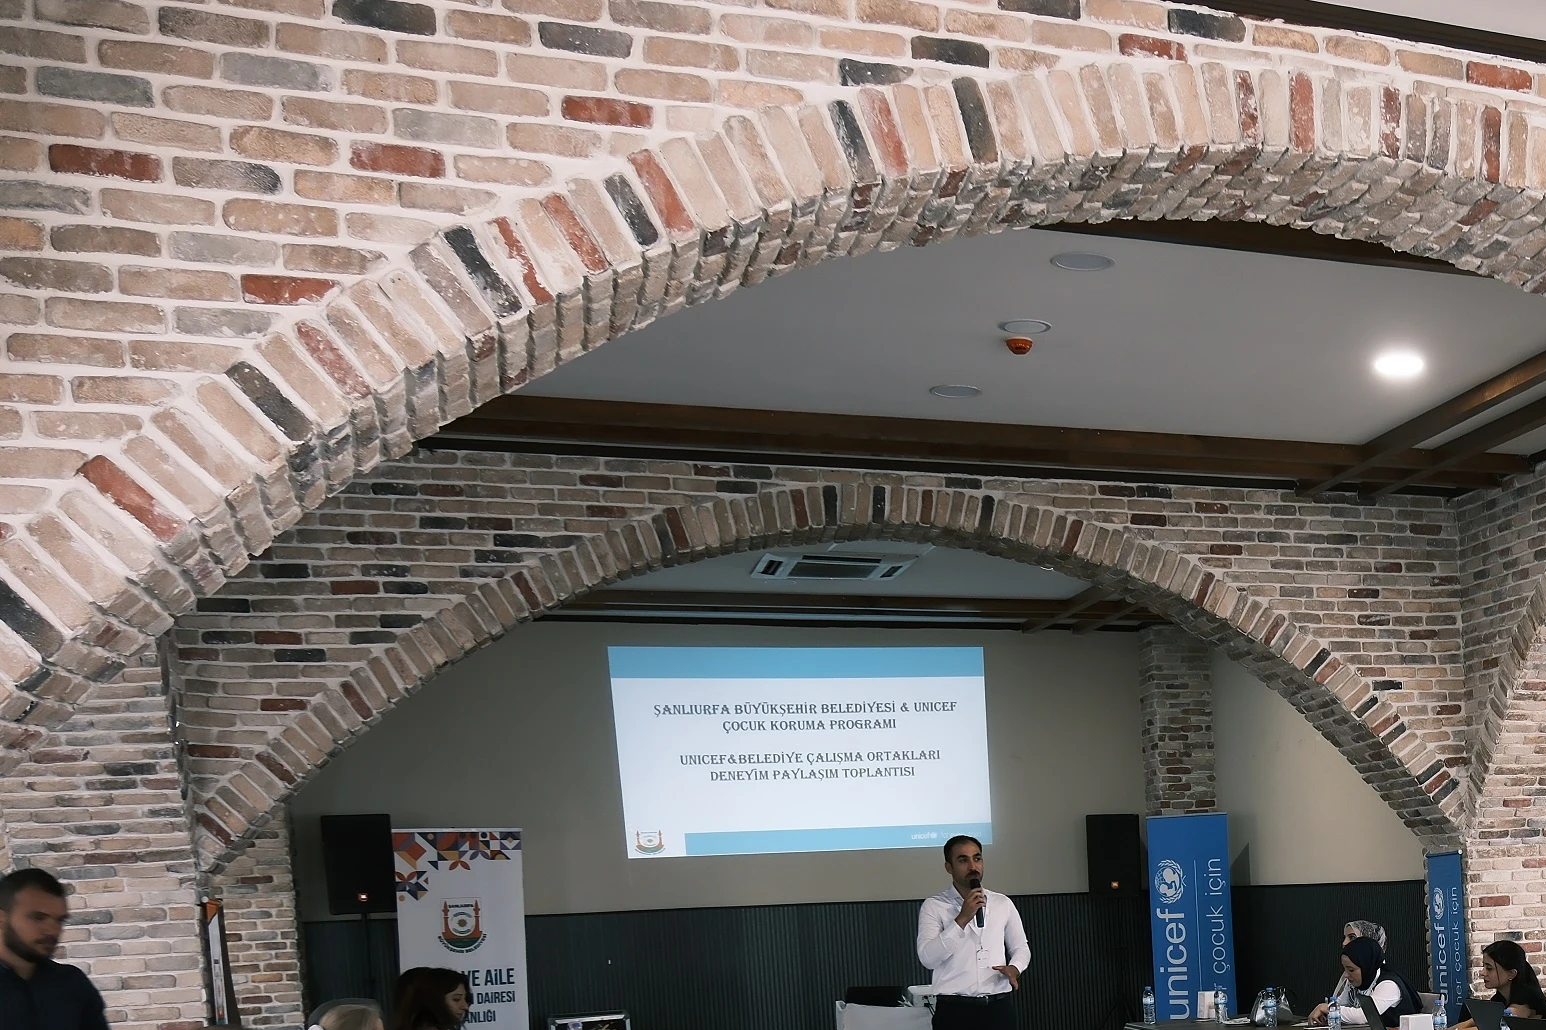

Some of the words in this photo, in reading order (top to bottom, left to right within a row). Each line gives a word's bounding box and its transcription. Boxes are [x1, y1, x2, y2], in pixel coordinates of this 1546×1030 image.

[653, 704, 731, 717] ŞANLIURFA
[734, 702, 817, 717] BÜYÜKŞEHİR
[821, 701, 896, 714] BELEDİYESİ
[900, 702, 910, 713] &
[914, 701, 957, 713] UNICEF
[722, 720, 766, 734] ÇOCUK
[770, 719, 826, 731] KORUMA
[830, 718, 897, 731] PROGRAMI
[806, 751, 864, 765] ÇALIŞMA
[867, 749, 941, 762] ORTAKLARI
[710, 768, 769, 782] DENEYİM
[772, 767, 839, 781] PAYLAŞIM
[842, 766, 915, 780] TOPLANTISI
[1203, 857, 1227, 896] için
[1450, 887, 1460, 915] için
[1205, 904, 1231, 974] çocuk
[1451, 921, 1464, 972] çocuk
[1156, 907, 1191, 1020] unicef
[1433, 922, 1449, 1005] unicef
[1454, 978, 1464, 1006] her
